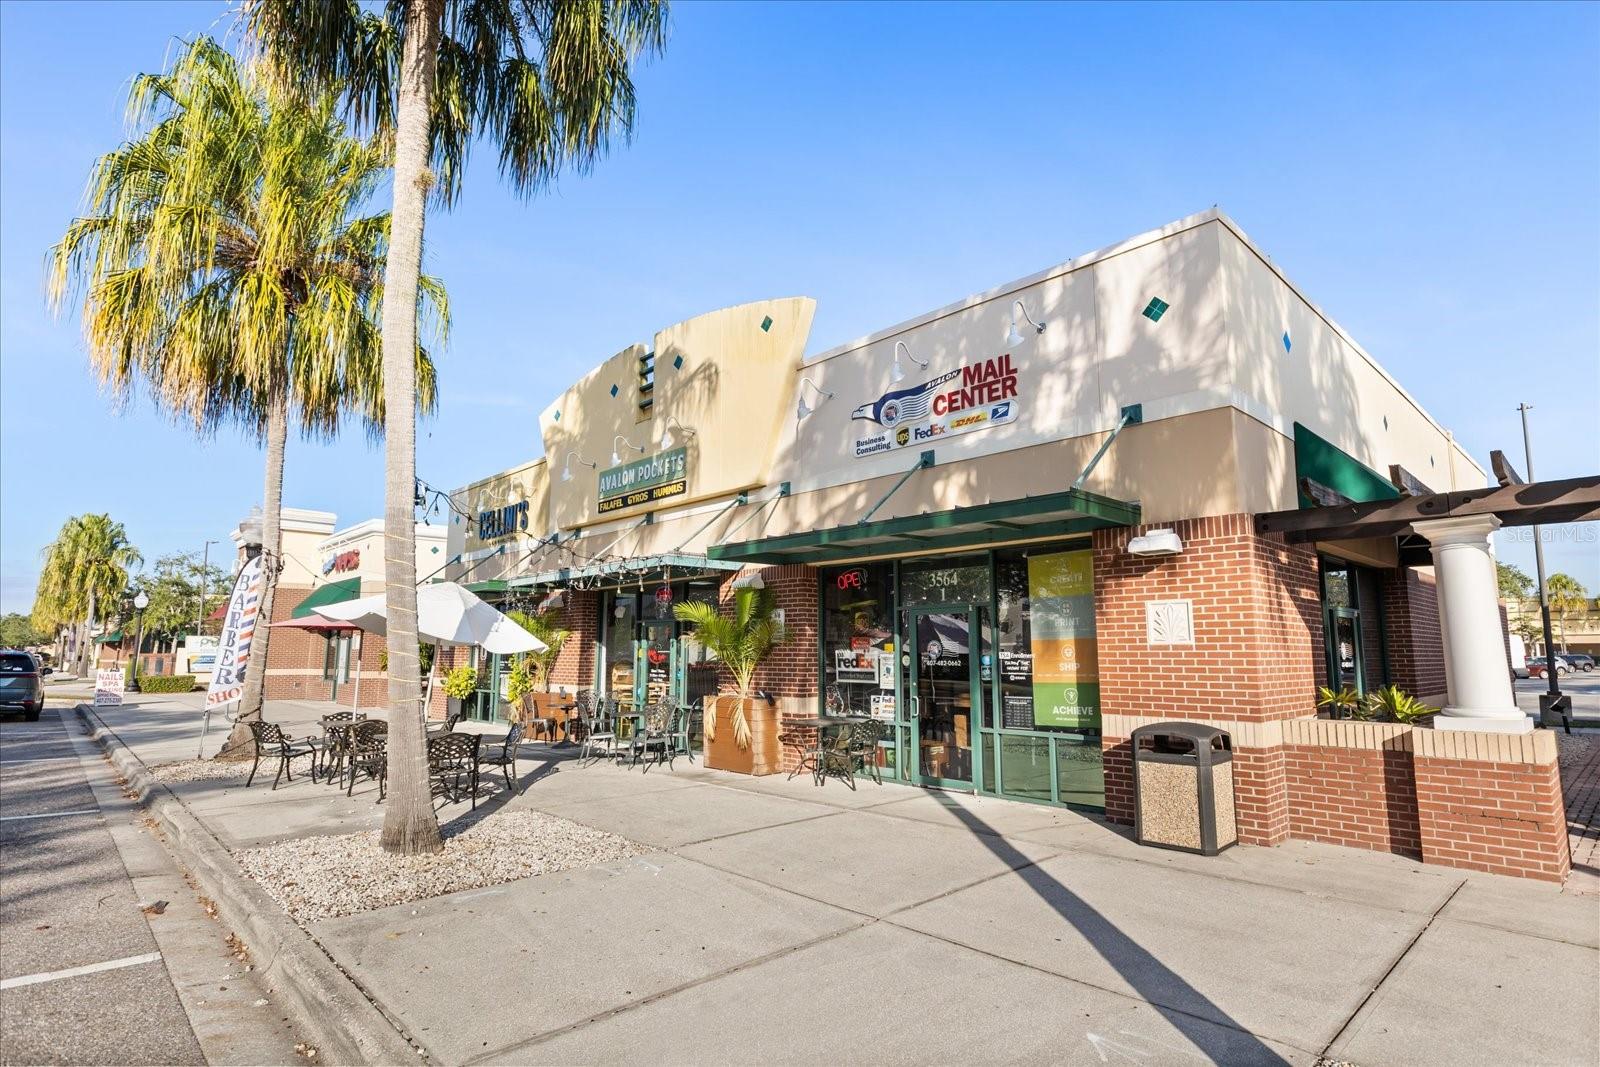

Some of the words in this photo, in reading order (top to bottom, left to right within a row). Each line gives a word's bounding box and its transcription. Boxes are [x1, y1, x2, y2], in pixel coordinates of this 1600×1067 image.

[925, 369, 959, 389] AVALON
[962, 354, 1018, 387] MAIL
[932, 375, 1018, 416] CENTER
[914, 423, 946, 440] FedEx
[856, 436, 886, 448] Business
[856, 441, 891, 455] Consulting
[599, 469, 635, 493] AVALON
[638, 453, 684, 480] POCKETS
[599, 498, 623, 511] FALAFEL
[627, 491, 648, 505] GYROS
[653, 482, 683, 498] HUMMUS
[479, 500, 529, 540] CELLINI'S
[929, 571, 958, 587] 3564
[940, 588, 946, 601] 1
[214, 574, 250, 685] BARBER
[1058, 662, 1080, 672] SHIP
[98, 673, 124, 681] NAILS
[1052, 705, 1094, 716] ACHIEVE
